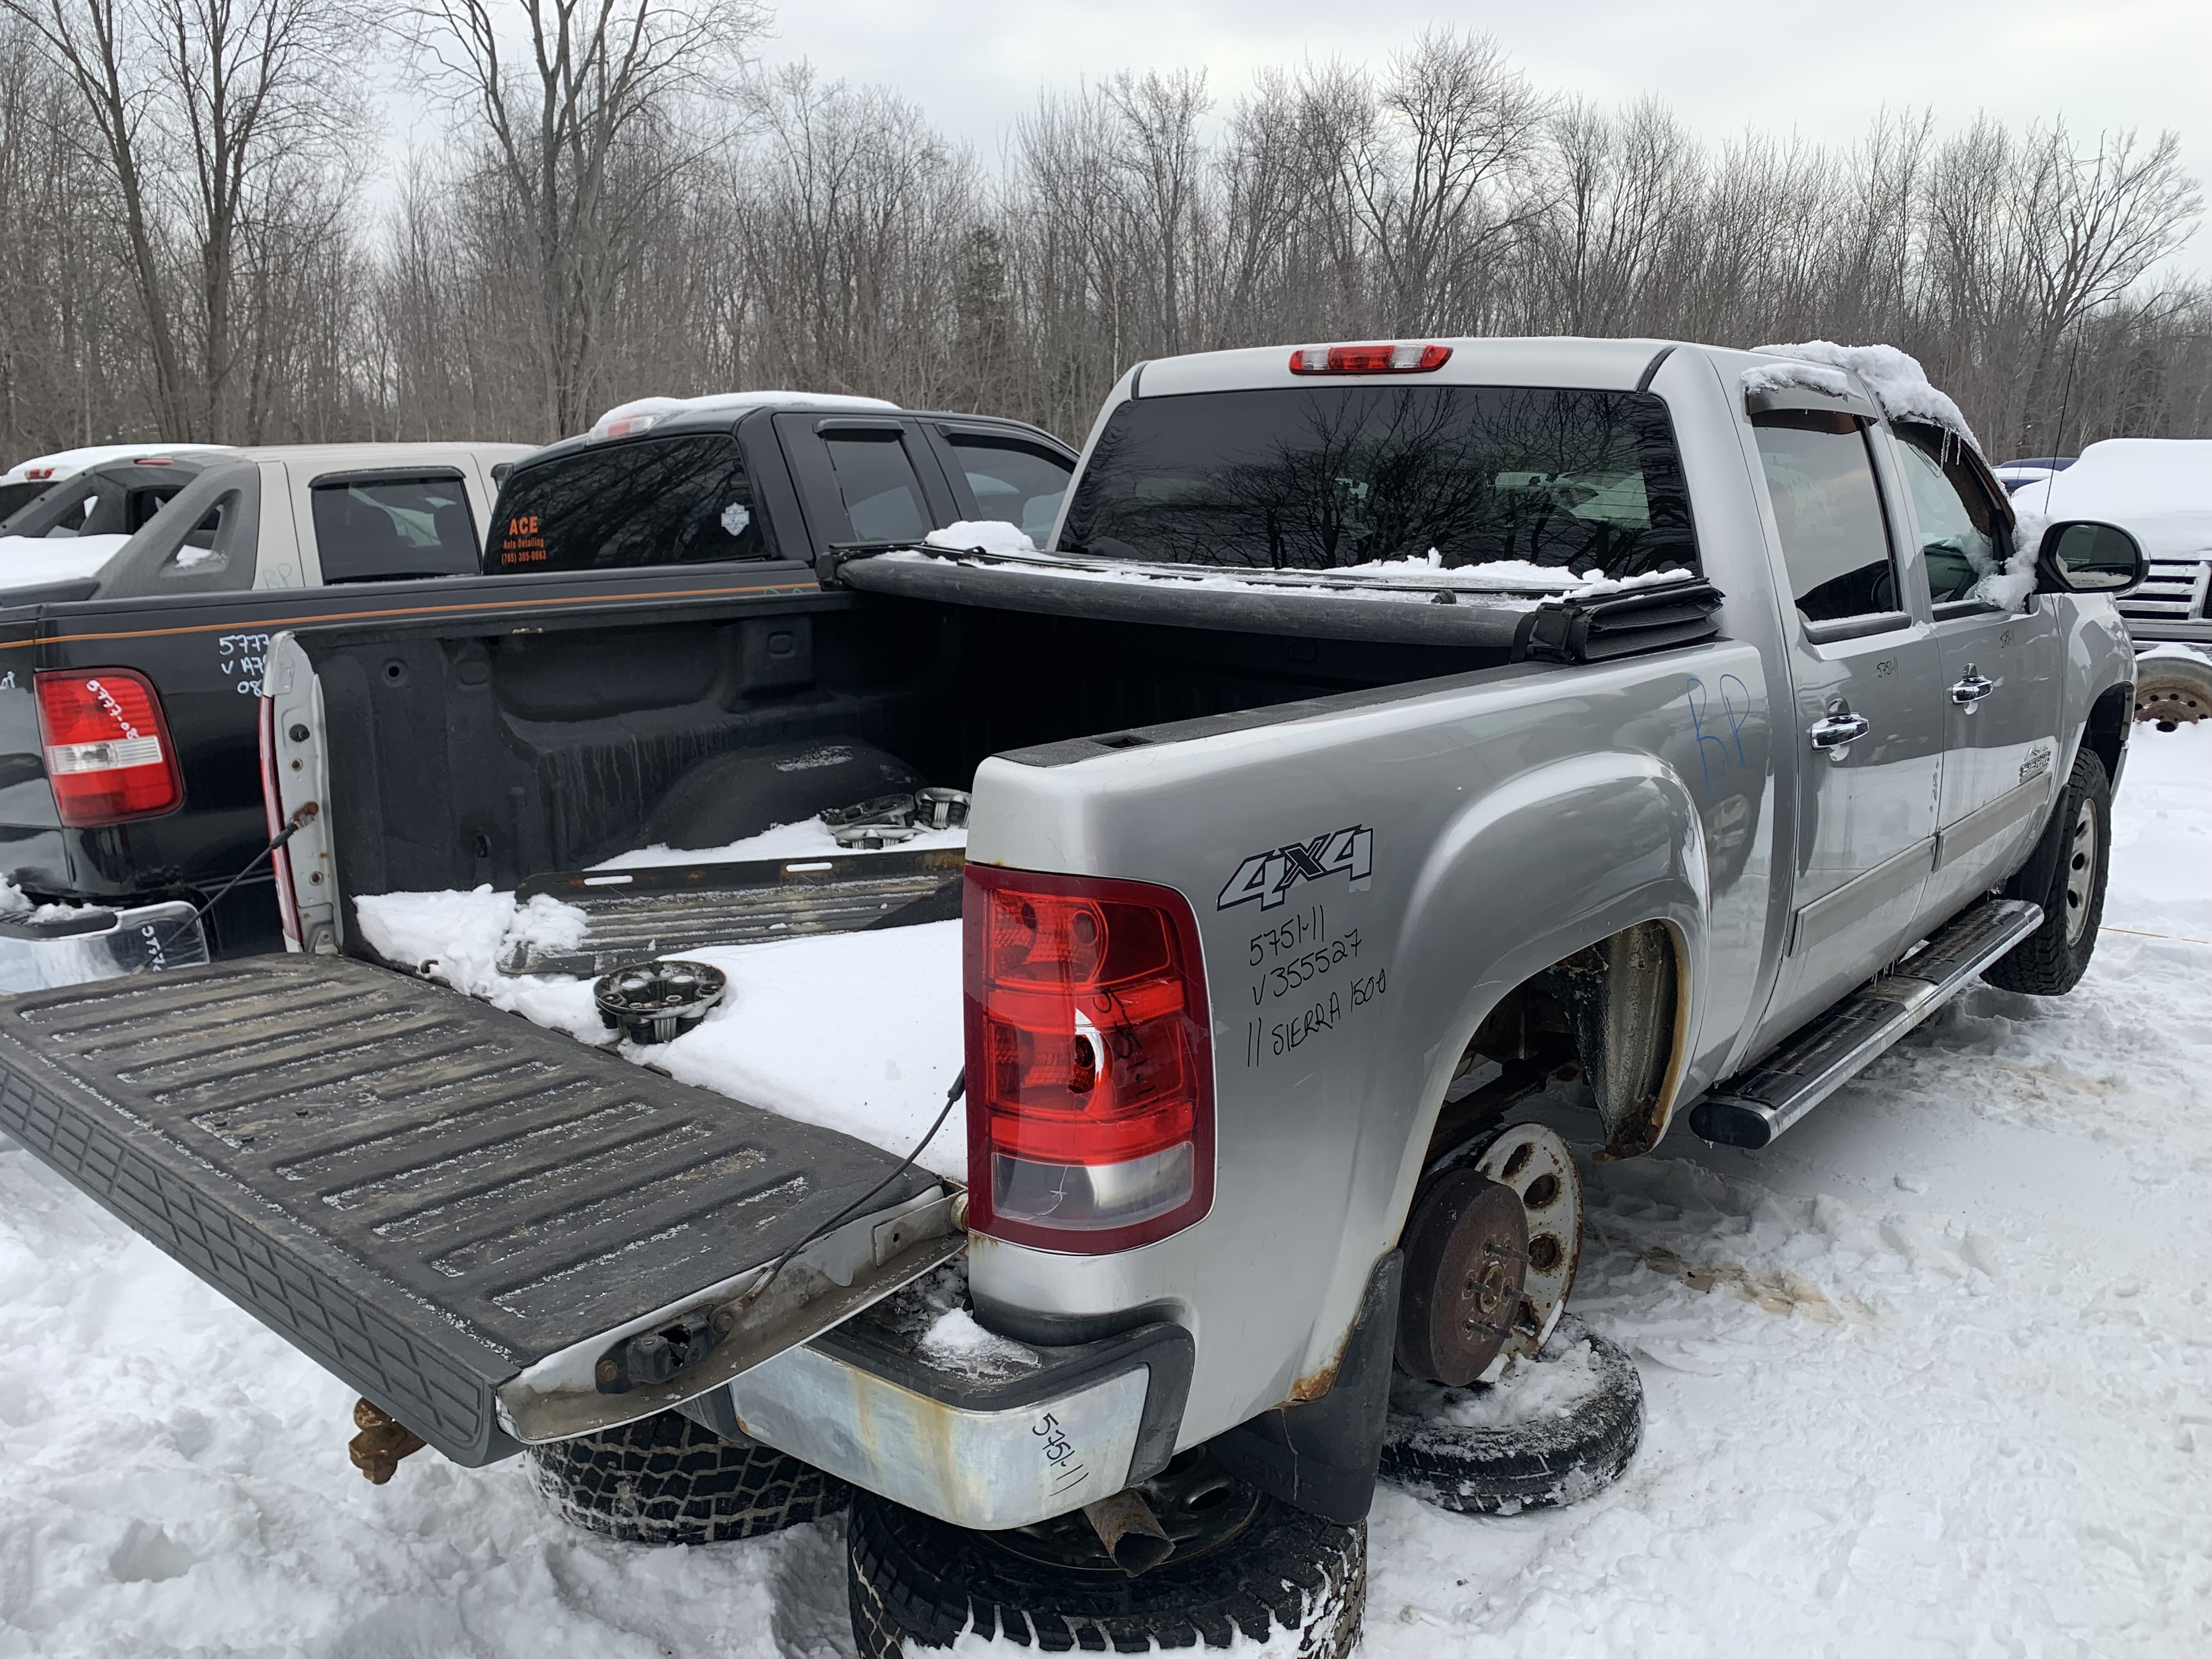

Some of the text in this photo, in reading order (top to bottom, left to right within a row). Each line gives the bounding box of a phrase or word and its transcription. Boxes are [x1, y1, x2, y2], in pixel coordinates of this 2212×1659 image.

[509, 515, 539, 535] ACE
[503, 537, 545, 550] Auto Detailing
[1272, 991, 1341, 1056] SIERRA
[1350, 968, 1386, 1012] 1500
